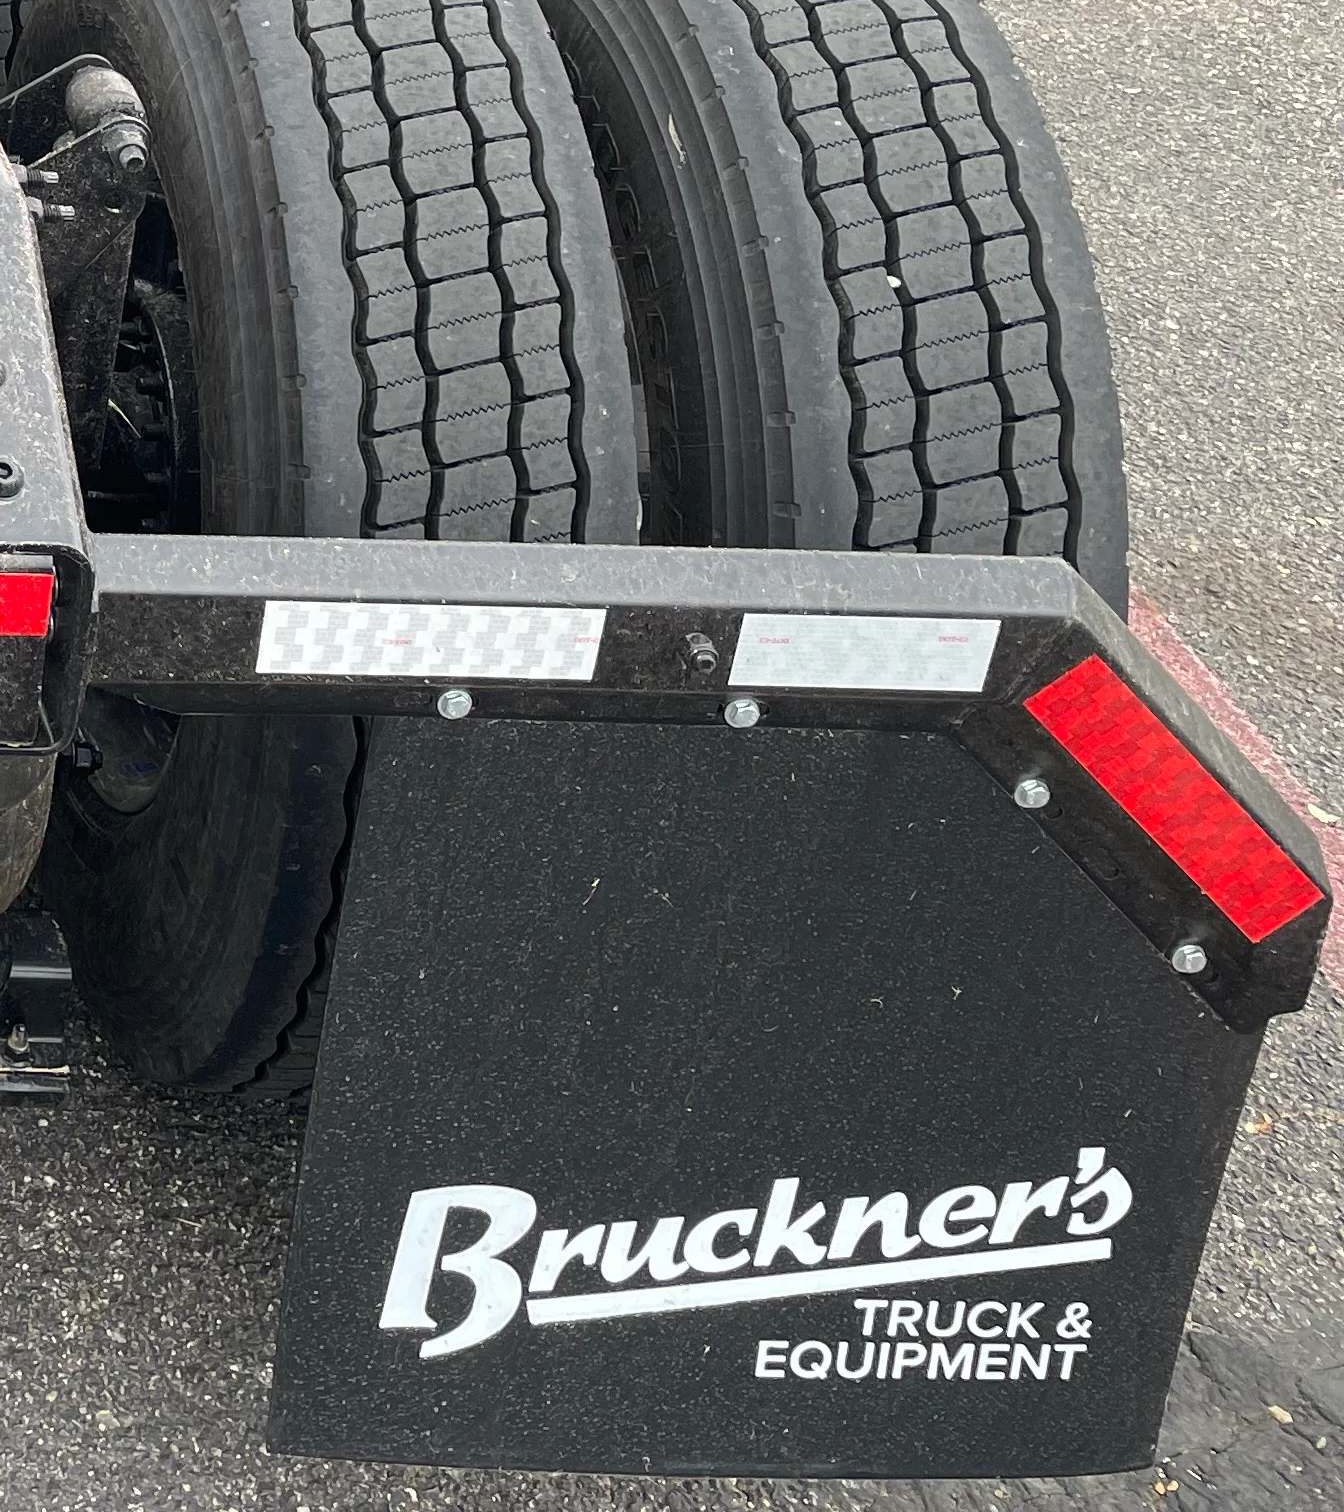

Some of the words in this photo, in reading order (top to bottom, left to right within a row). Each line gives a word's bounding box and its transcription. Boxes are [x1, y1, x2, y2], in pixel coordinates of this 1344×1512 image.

[378, 1146, 1133, 1360] Bruckner's
[853, 1298, 1045, 1339] TRUCK
[1055, 1301, 1093, 1339] &
[754, 1339, 1088, 1380] EQUIPMENT
